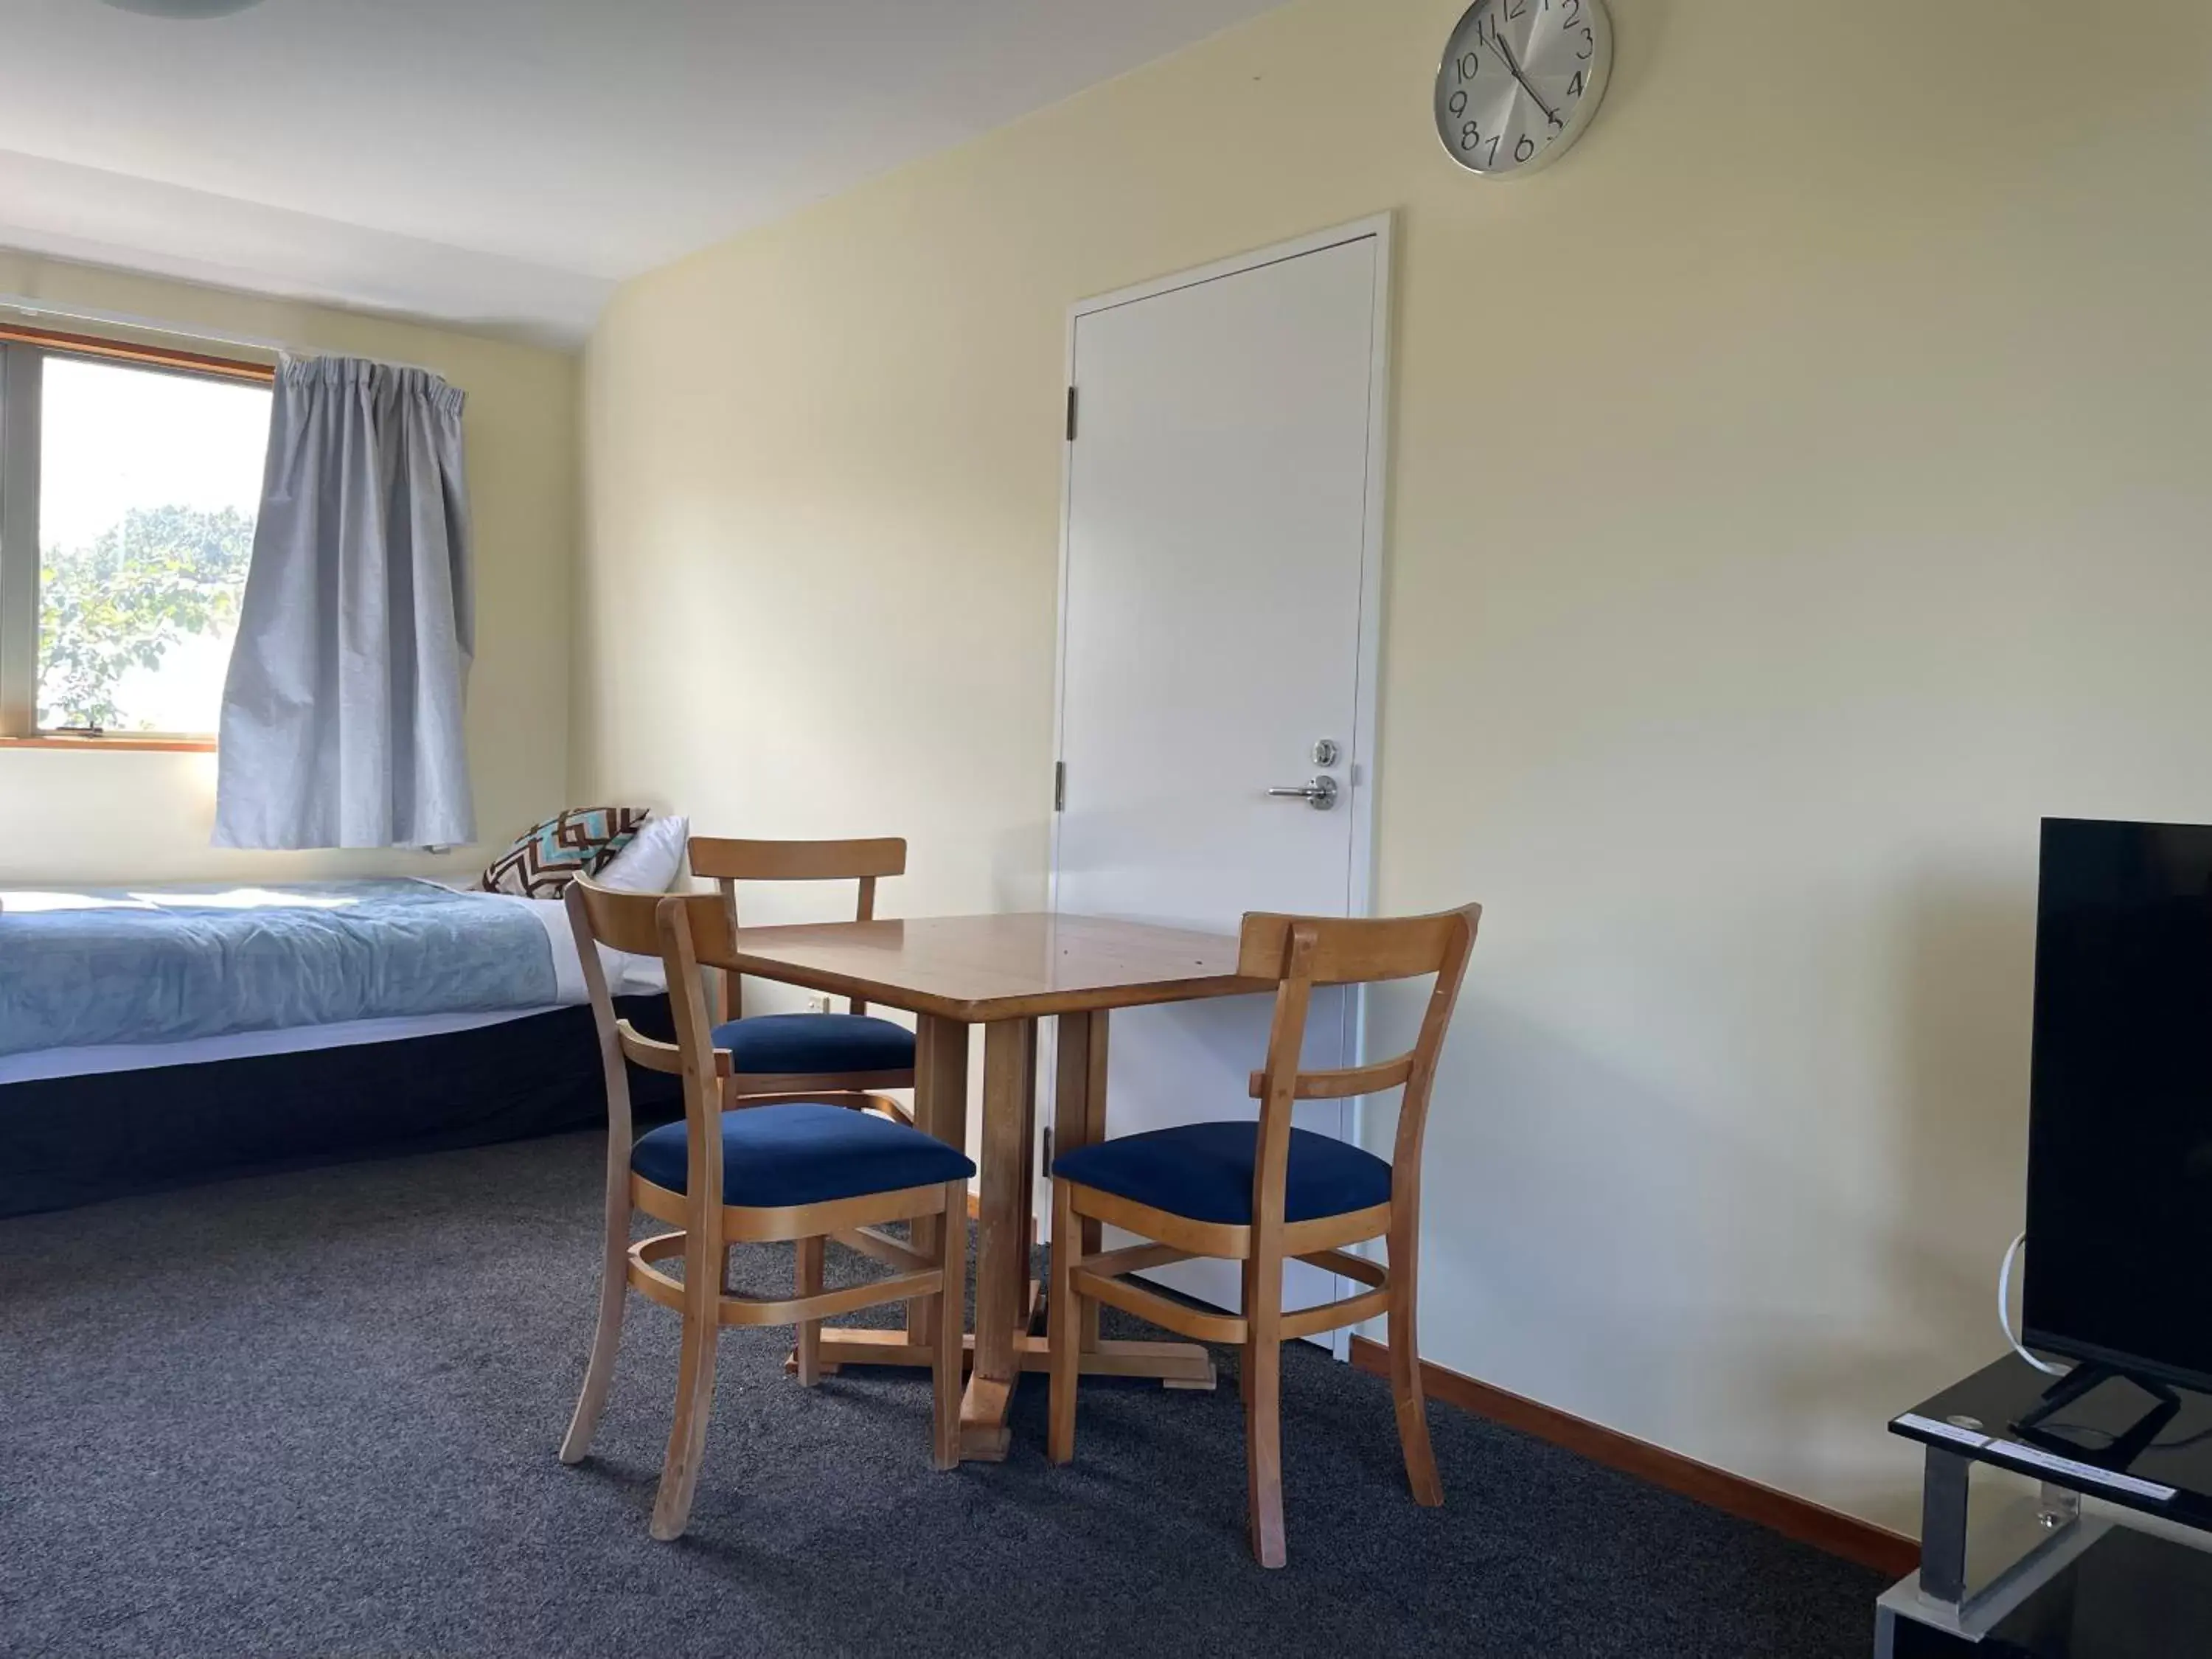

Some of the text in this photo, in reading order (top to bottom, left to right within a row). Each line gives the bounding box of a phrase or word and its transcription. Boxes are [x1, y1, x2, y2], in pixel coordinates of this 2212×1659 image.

[1503, 0, 1526, 22] 12
[1562, 0, 1580, 29] 2
[1478, 13, 1495, 46] 11
[1576, 27, 1593, 59] 3
[1456, 52, 1478, 84] 10
[1567, 71, 1584, 98] 4
[1449, 91, 1467, 118] 9
[1461, 120, 1479, 150] 8
[1548, 108, 1564, 140] 5
[1485, 135, 1500, 166] 7
[1514, 133, 1534, 162] 6
